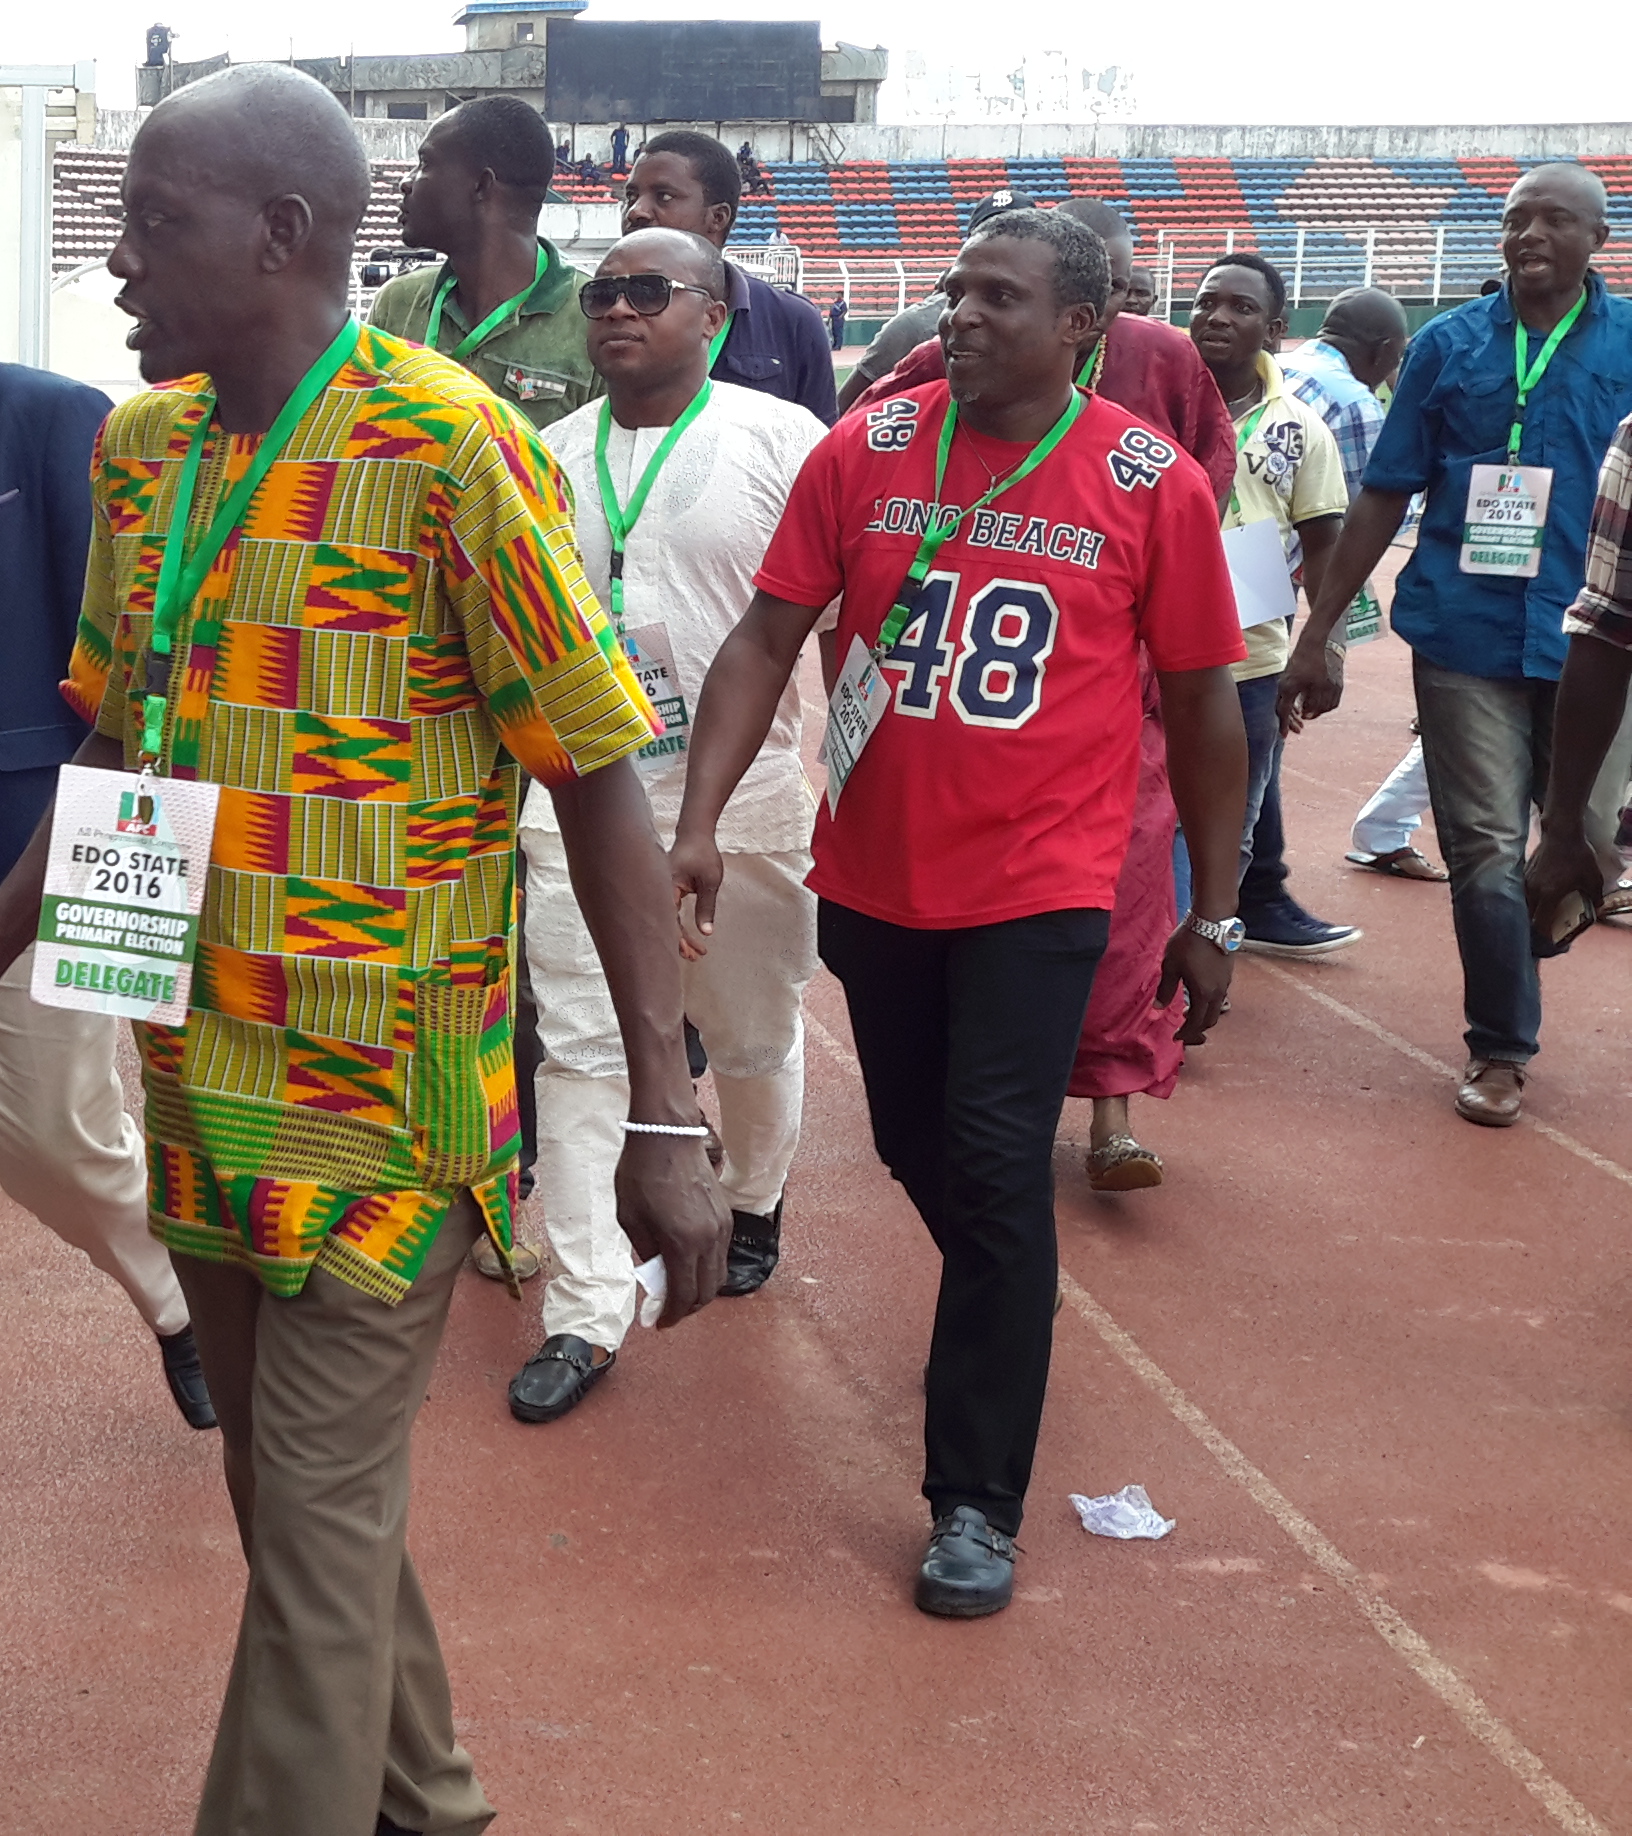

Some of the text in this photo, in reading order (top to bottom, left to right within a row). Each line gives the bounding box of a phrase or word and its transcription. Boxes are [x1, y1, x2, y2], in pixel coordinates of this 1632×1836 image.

[866, 398, 919, 452] 48
[1106, 427, 1178, 492] 48
[1476, 499, 1537, 511] EDO STATE
[1487, 508, 1522, 521] 2016
[967, 508, 1106, 570] BEACH
[880, 570, 1060, 730] 48
[839, 704, 857, 739] 2016
[840, 682, 853, 706] EDO
[851, 704, 868, 737] STATE
[72, 844, 189, 877] EDO STATE
[94, 868, 161, 899] 2016
[55, 902, 189, 938] GOVERNORSHIP
[55, 922, 185, 956] PRIMARY ELECTION
[54, 958, 177, 1003] DELEGATE
